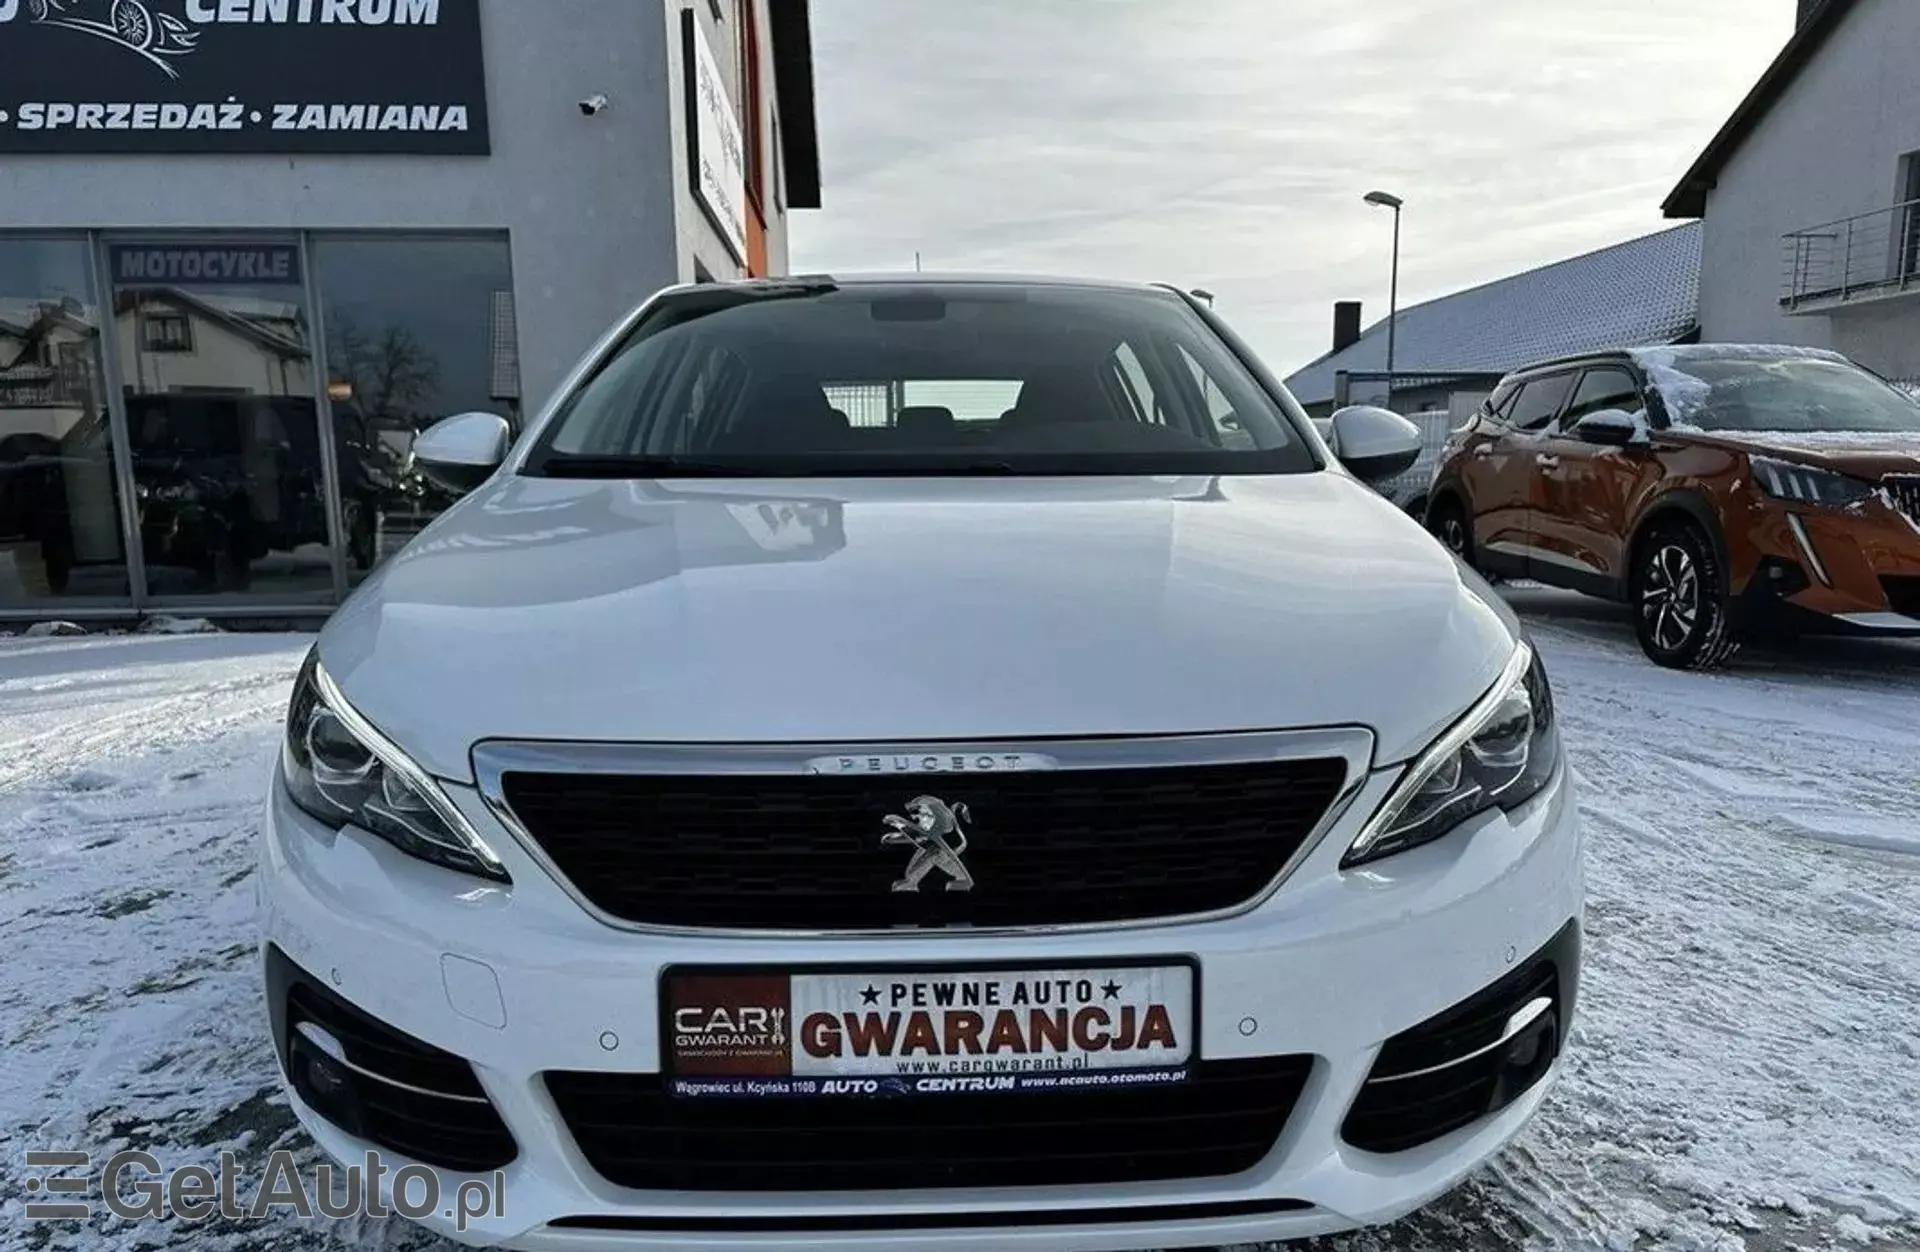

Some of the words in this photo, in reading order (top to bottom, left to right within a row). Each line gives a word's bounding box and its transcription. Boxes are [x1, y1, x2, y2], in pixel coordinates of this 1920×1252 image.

[185, 0, 440, 25] CENTRUM
[17, 96, 244, 130] SPRZEDAŻ
[271, 104, 468, 131] ZAMIANA
[120, 251, 290, 279] MOTOCYKLE
[838, 756, 1021, 770] PEUGEOT
[890, 982, 1001, 1007] PEWNE
[1012, 979, 1093, 1005] AUTO
[675, 1007, 768, 1033] CAR
[800, 1004, 1177, 1058] GWARANCJA
[675, 1033, 768, 1047] GWARANT
[821, 1079, 878, 1094] AUTO
[916, 1076, 1016, 1092] CENTRUM
